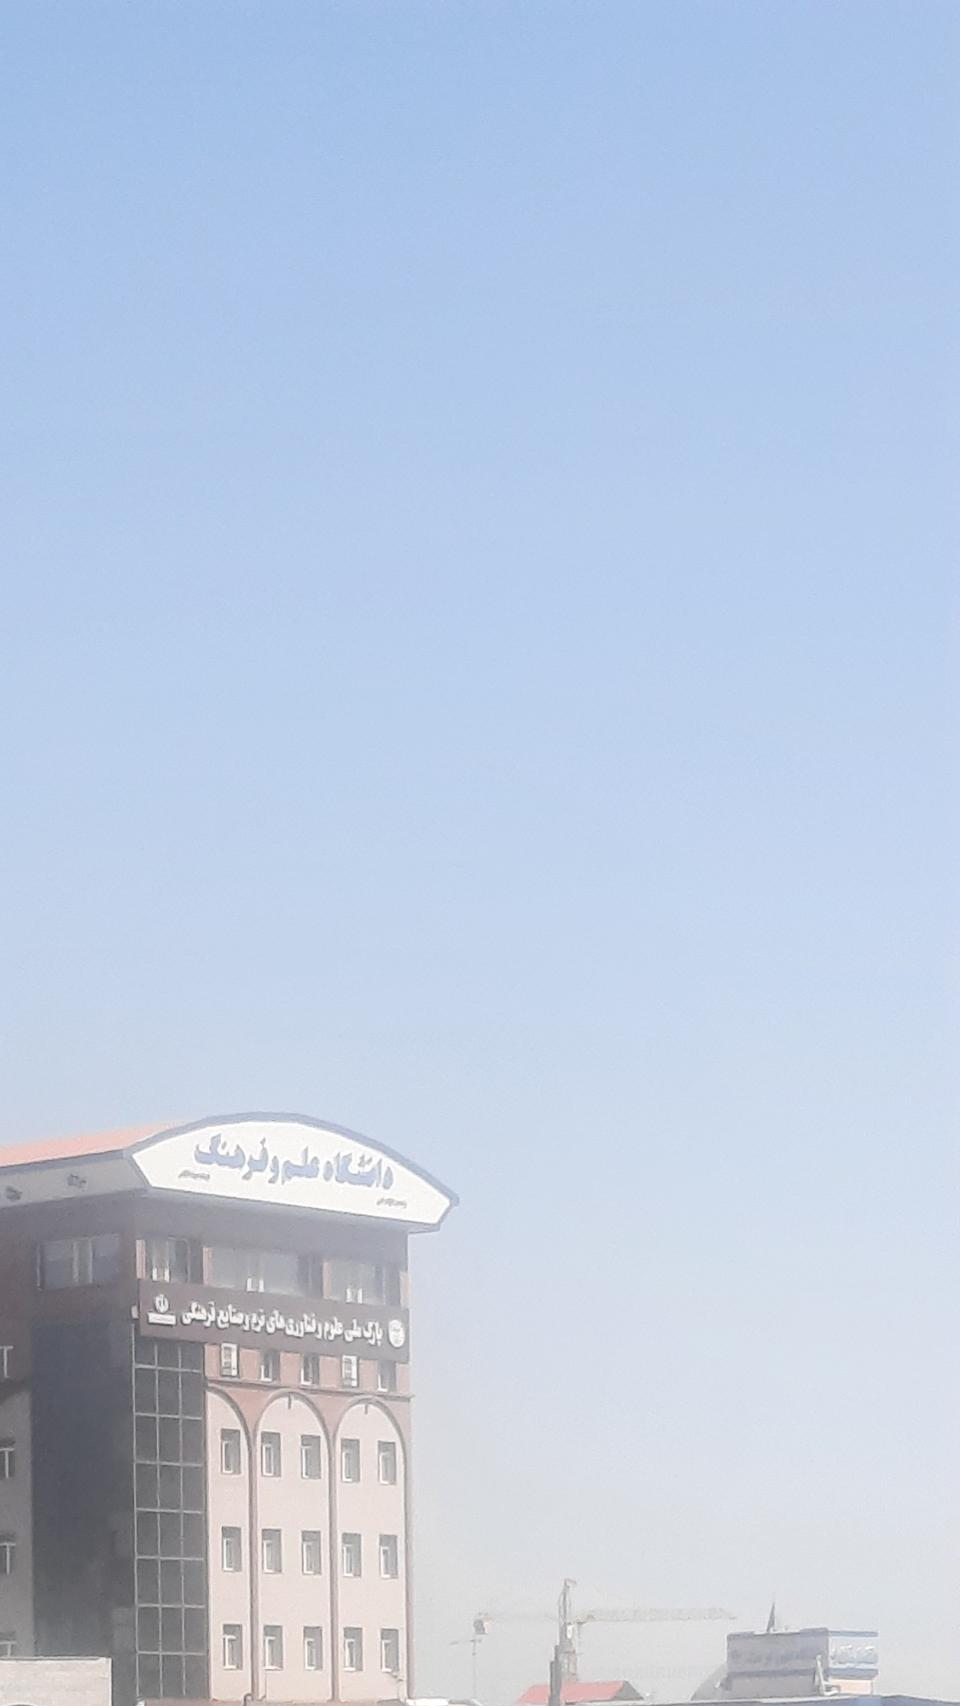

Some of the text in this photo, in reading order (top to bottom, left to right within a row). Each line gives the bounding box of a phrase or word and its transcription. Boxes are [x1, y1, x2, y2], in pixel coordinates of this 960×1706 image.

[194, 1133, 394, 1189] دانشگاه علم و فرهنگ
